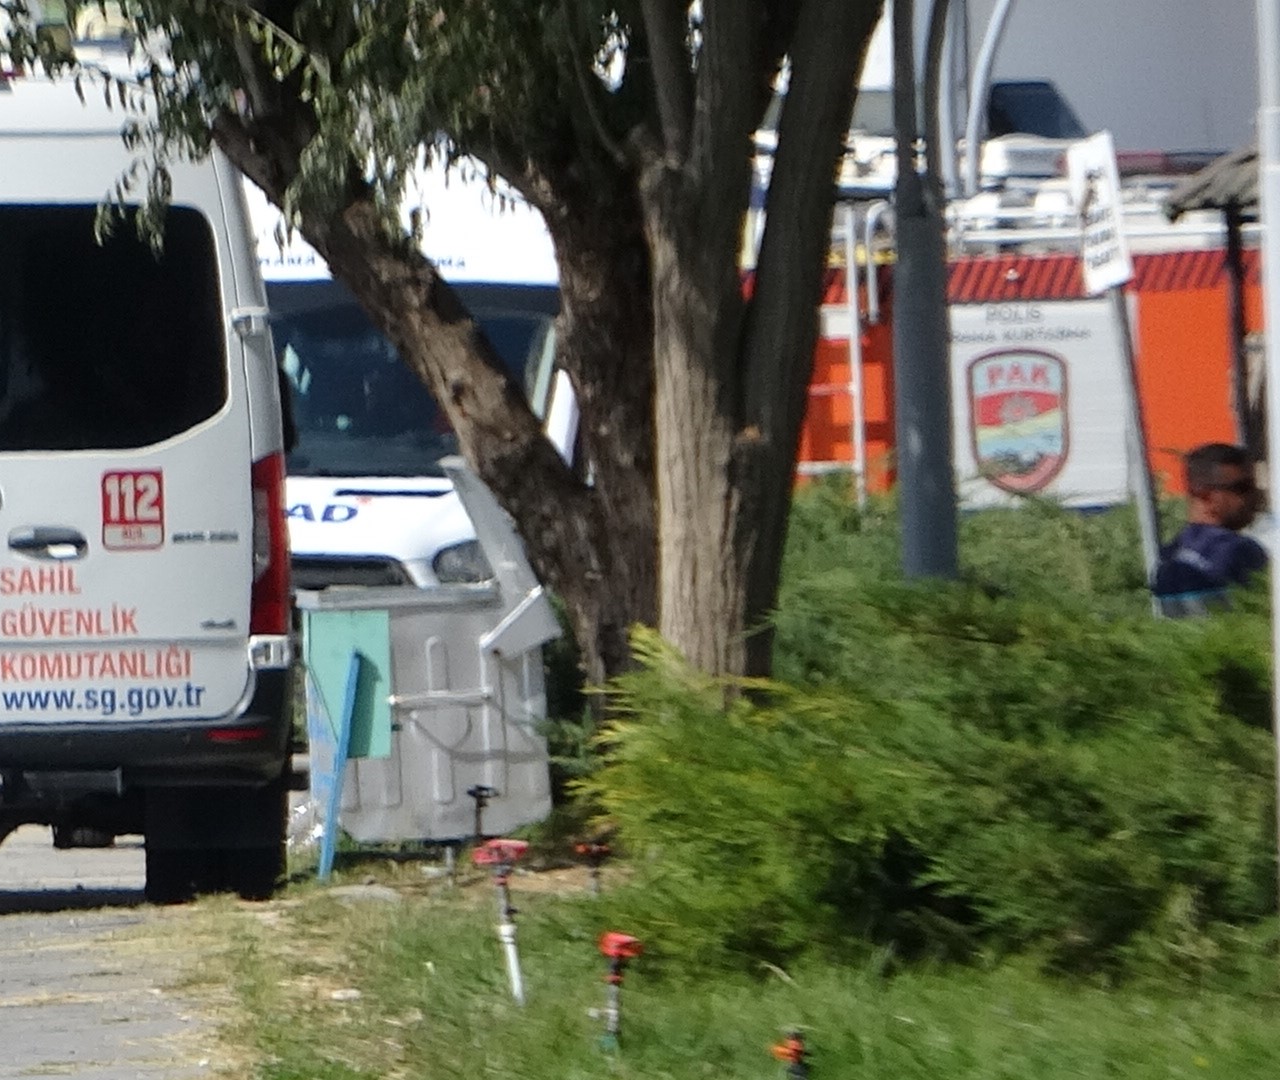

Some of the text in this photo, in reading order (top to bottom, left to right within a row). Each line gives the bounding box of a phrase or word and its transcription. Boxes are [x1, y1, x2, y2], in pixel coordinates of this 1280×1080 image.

[986, 363, 1049, 385] PAK
[106, 474, 161, 521] 112
[0, 560, 82, 595] SAHİL
[0, 601, 139, 637] GÜVENLİK
[0, 643, 193, 682] KOMUTANLIĞI
[2, 682, 206, 716] www.sg.gov.tr
